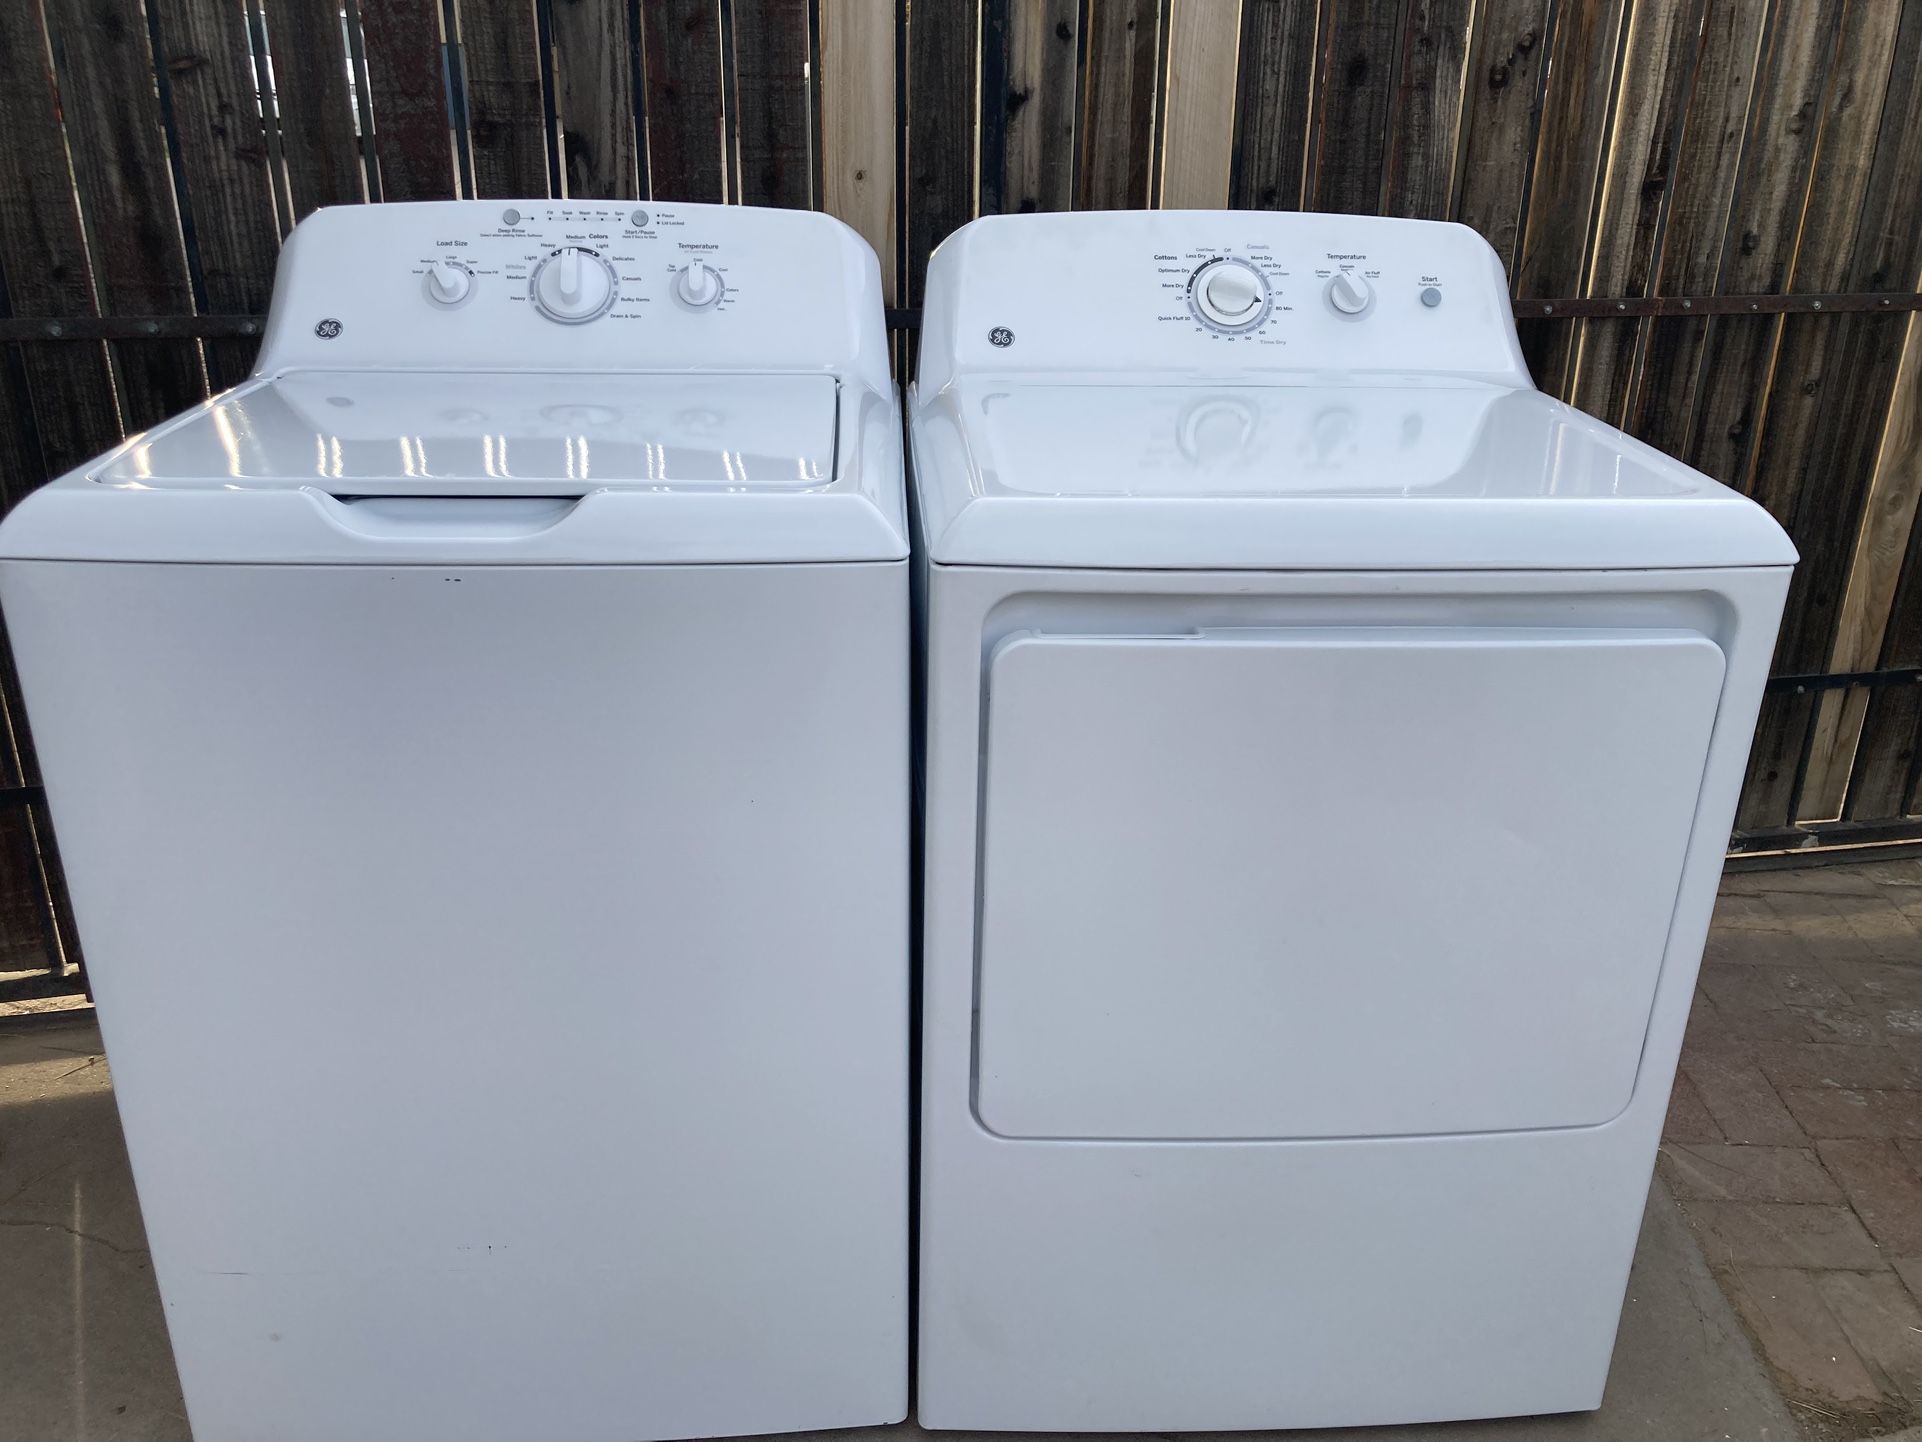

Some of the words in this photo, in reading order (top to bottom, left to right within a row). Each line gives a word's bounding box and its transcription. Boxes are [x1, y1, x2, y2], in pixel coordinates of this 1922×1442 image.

[677, 242, 719, 250] Temperature
[1326, 252, 1367, 260] Temperature
[314, 317, 344, 340] GE
[987, 325, 1016, 348] GE
